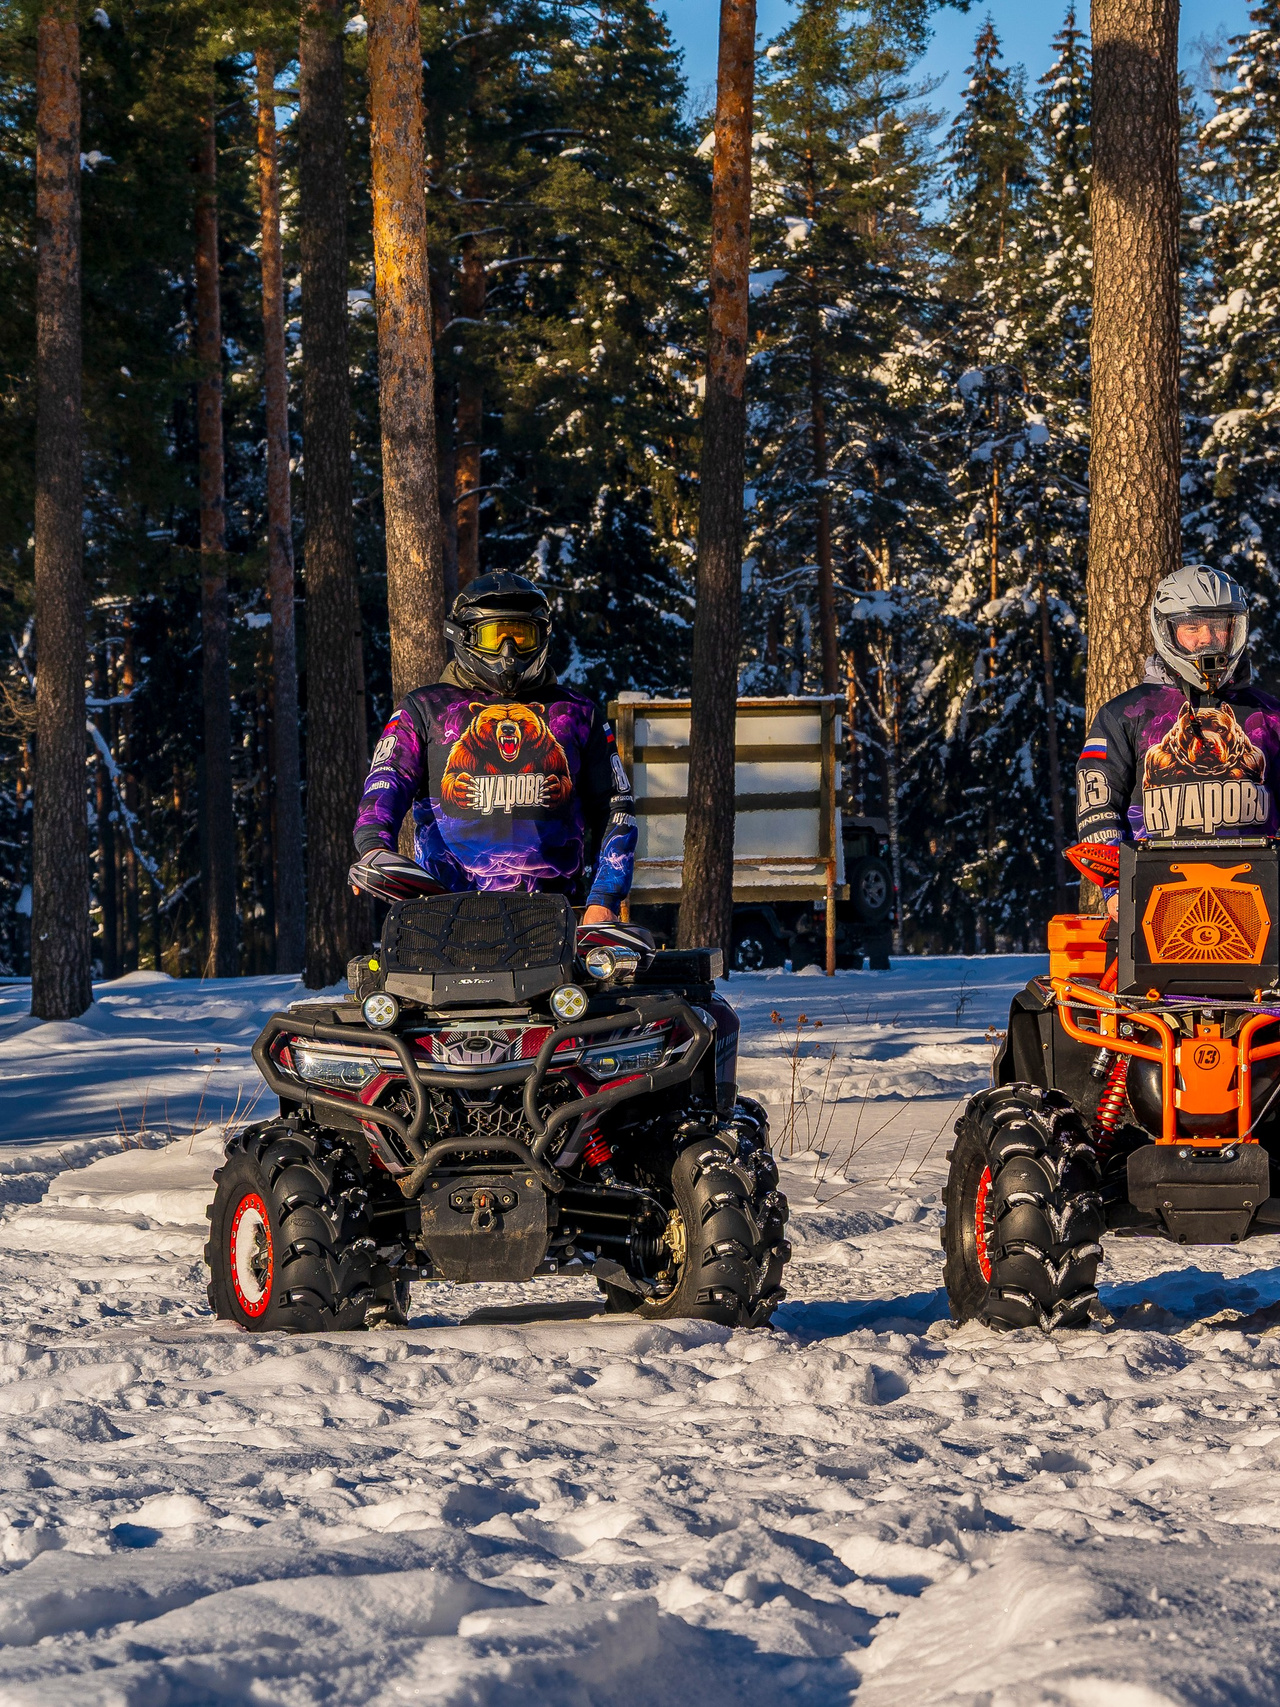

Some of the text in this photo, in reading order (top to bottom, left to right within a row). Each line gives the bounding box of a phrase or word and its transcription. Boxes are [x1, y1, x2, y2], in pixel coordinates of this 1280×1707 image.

[1078, 768, 1112, 817] 13
[1078, 811, 1121, 832] PINDICH
[1090, 862, 1119, 877] can-
[1197, 1050, 1217, 1064] 13
